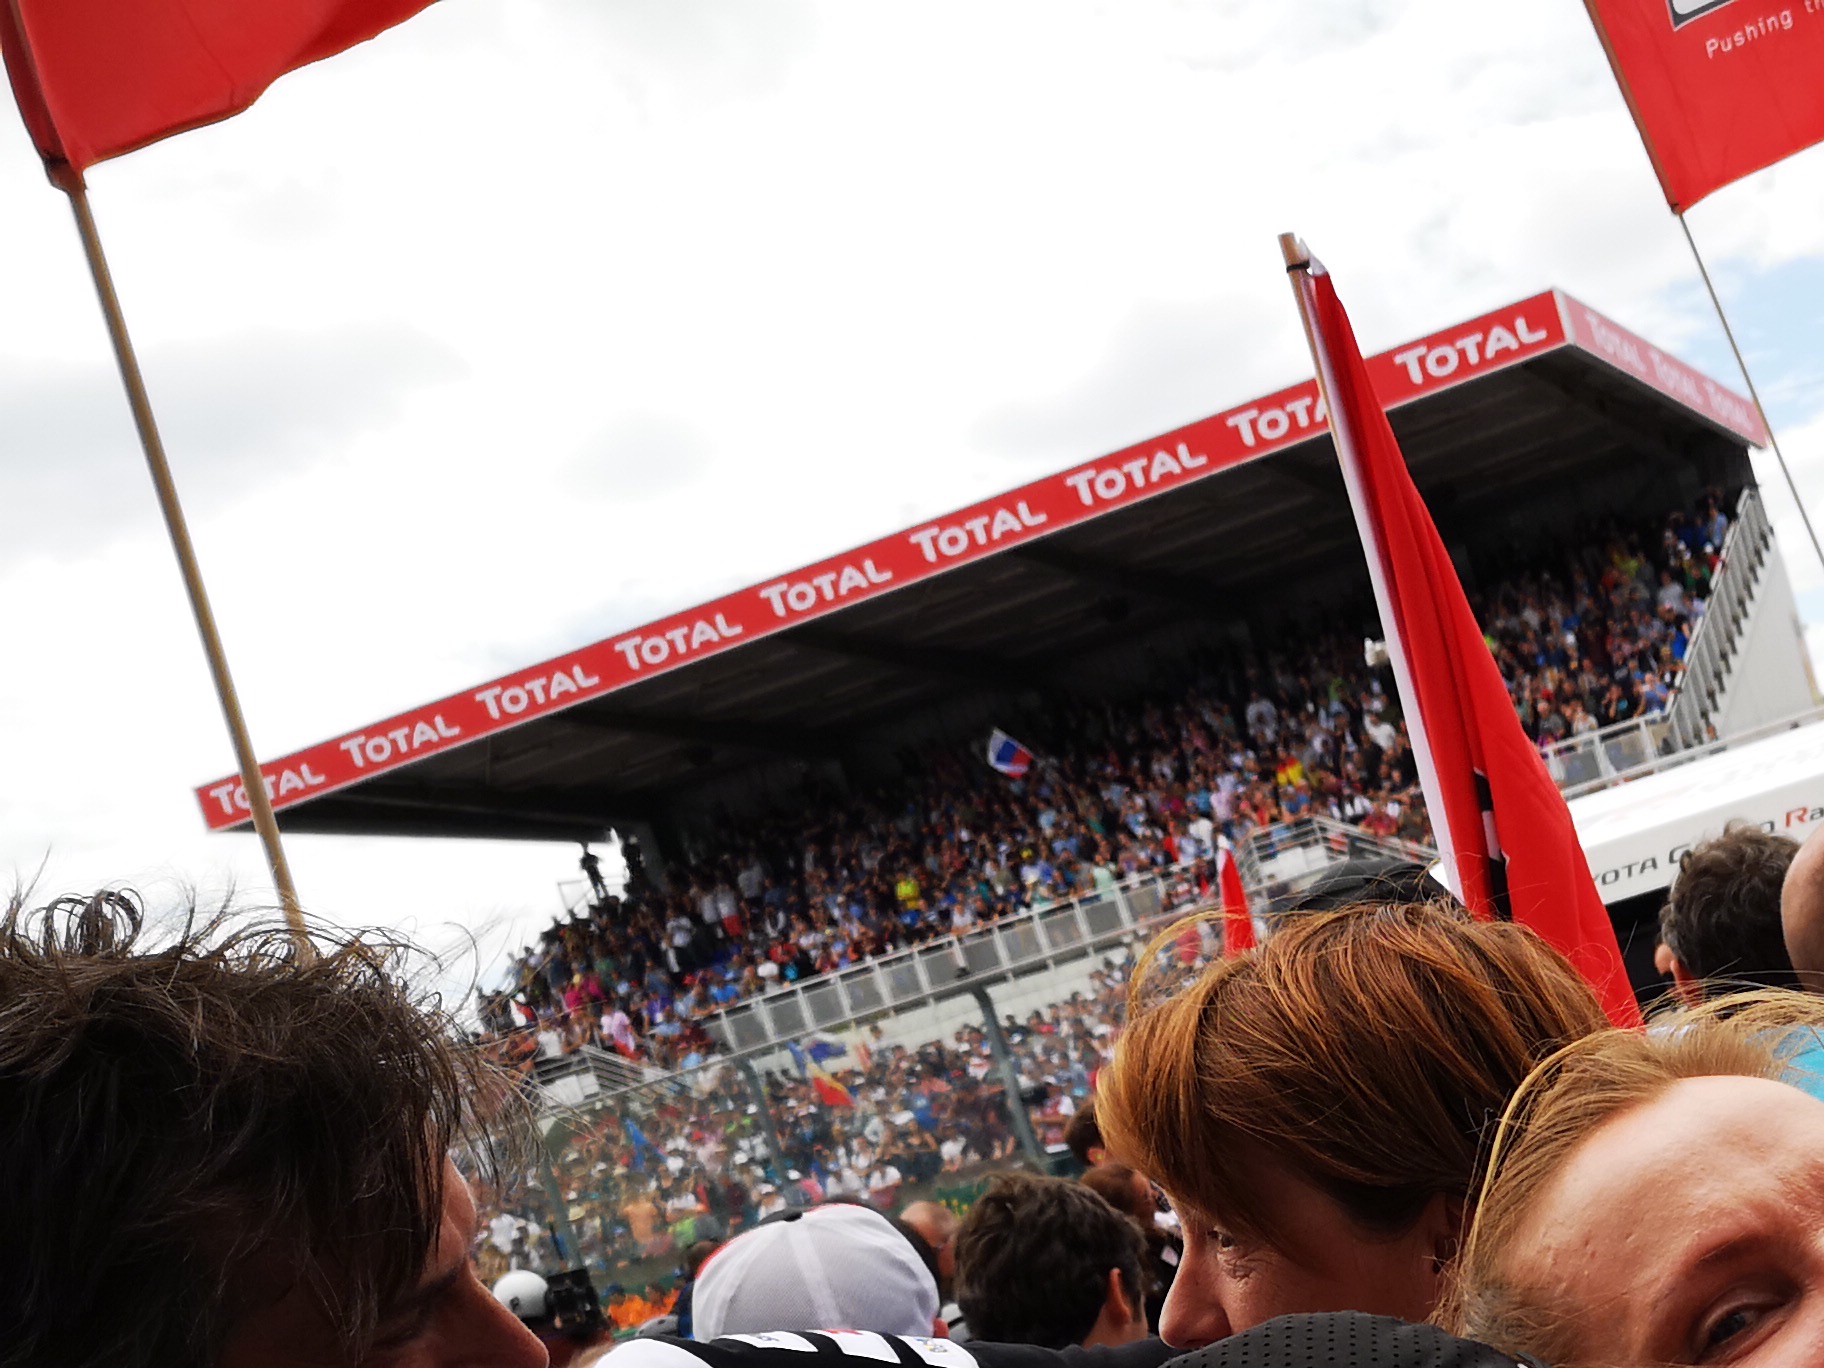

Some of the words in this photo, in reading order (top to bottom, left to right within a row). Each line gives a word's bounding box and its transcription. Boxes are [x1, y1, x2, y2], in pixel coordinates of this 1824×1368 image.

[1705, 8, 1795, 60] Pushing
[339, 714, 461, 768] TOTAL
[475, 664, 600, 720] TOTAL
[614, 612, 744, 671] TOTAL
[759, 558, 893, 618] TOTAL
[909, 500, 1048, 563] TOTAL
[1065, 442, 1208, 506] TOTAL
[1226, 396, 1330, 448] TOT
[1393, 316, 1548, 386] TOTAL
